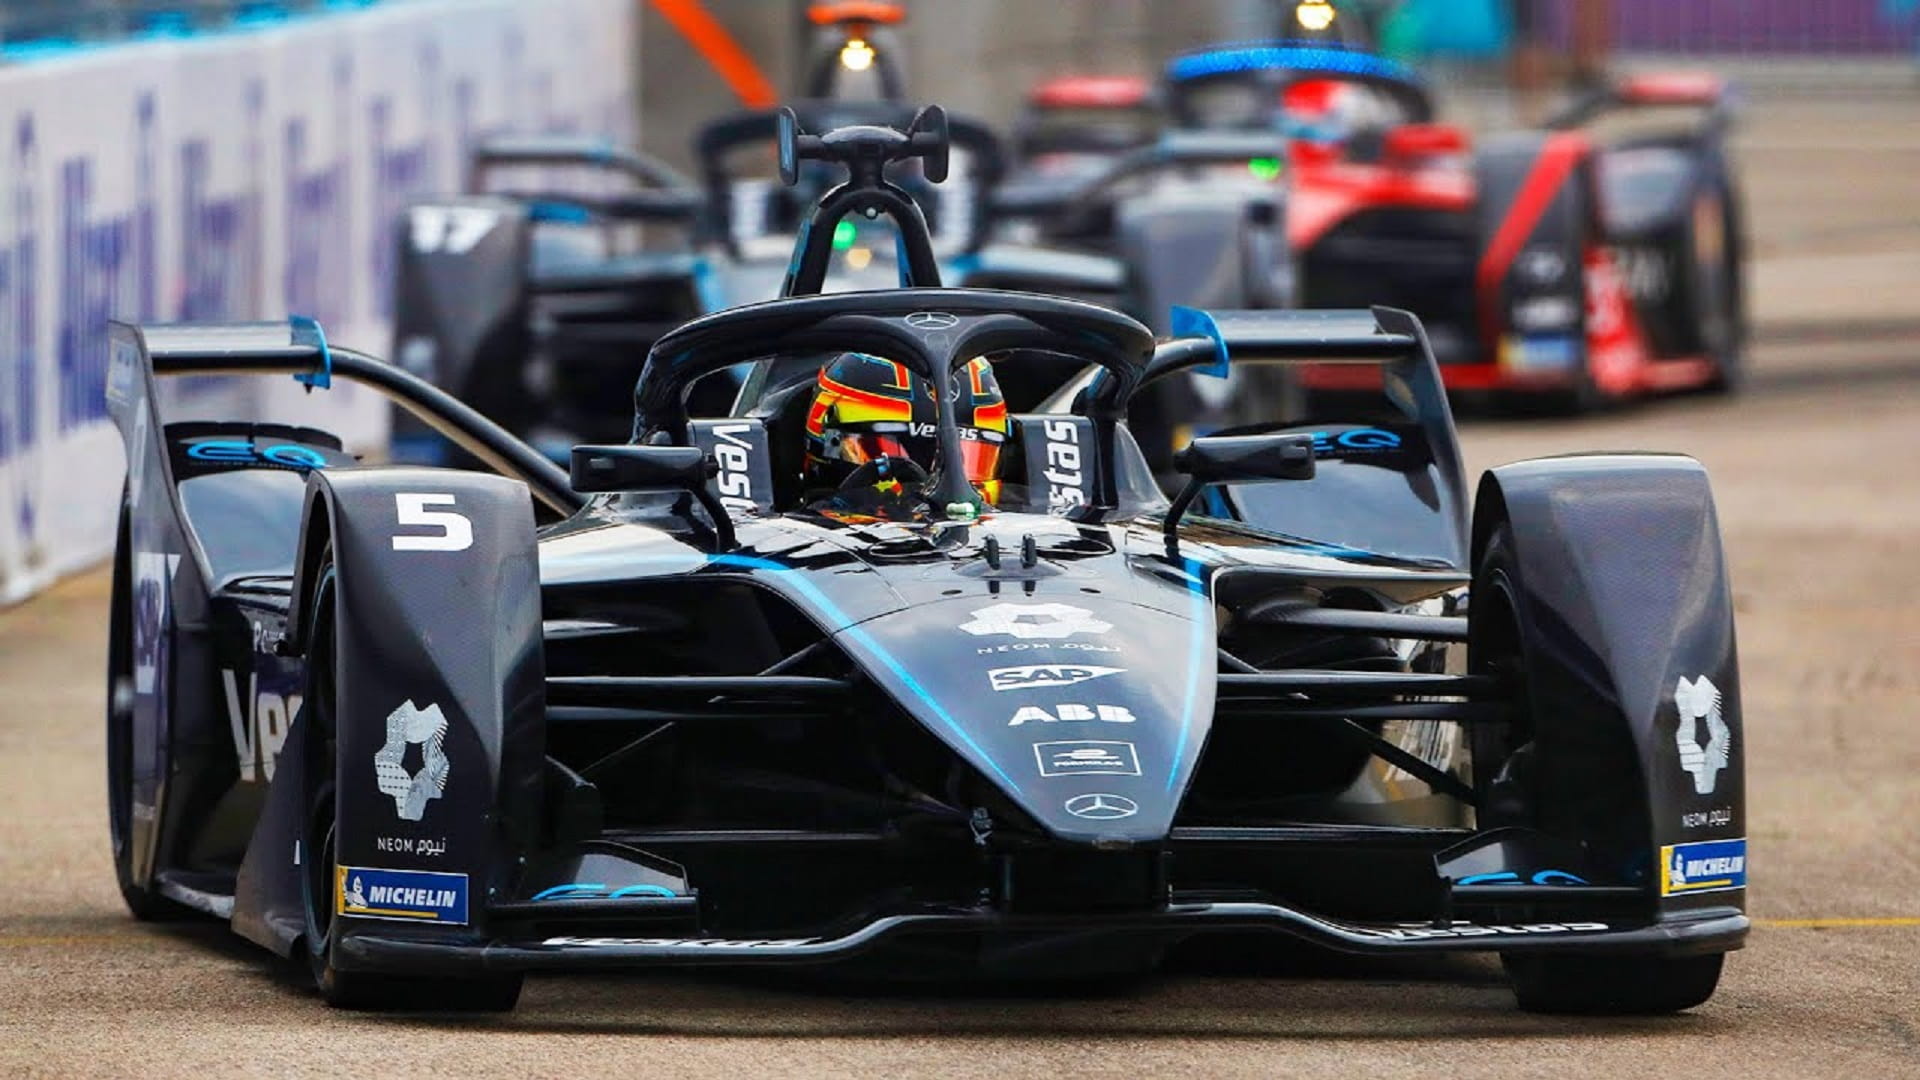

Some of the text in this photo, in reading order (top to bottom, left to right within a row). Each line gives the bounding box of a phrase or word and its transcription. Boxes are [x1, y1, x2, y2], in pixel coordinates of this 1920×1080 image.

[392, 493, 473, 551] 5
[993, 668, 1094, 685] SAP
[1008, 704, 1136, 726] ABB
[377, 837, 413, 852] NEOM
[1686, 856, 1744, 877] MICHELIN
[369, 886, 456, 908] MICHELIN
